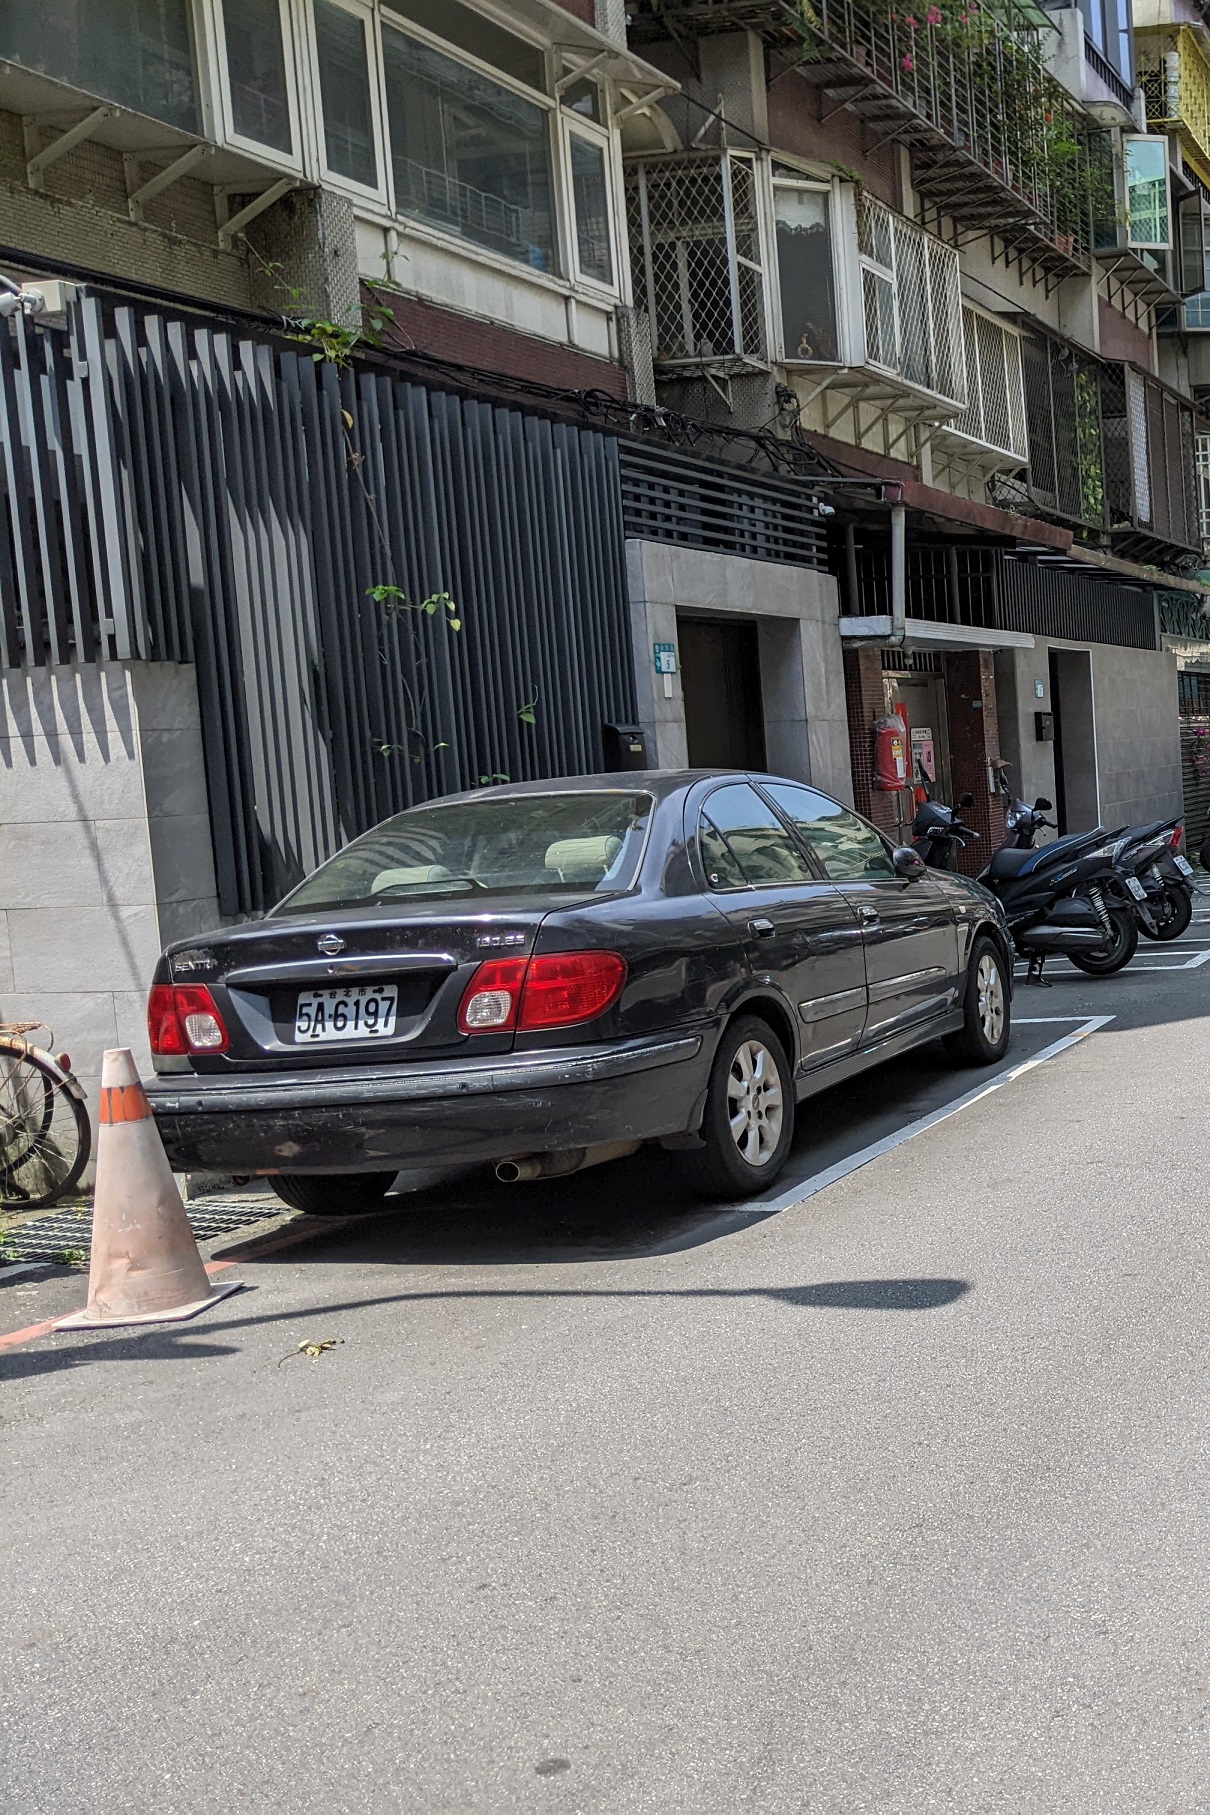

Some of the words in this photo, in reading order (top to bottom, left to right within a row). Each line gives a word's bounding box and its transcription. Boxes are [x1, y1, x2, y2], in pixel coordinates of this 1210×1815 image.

[328, 987, 368, 999] 台北市
[297, 995, 396, 1035] 5A-6197
